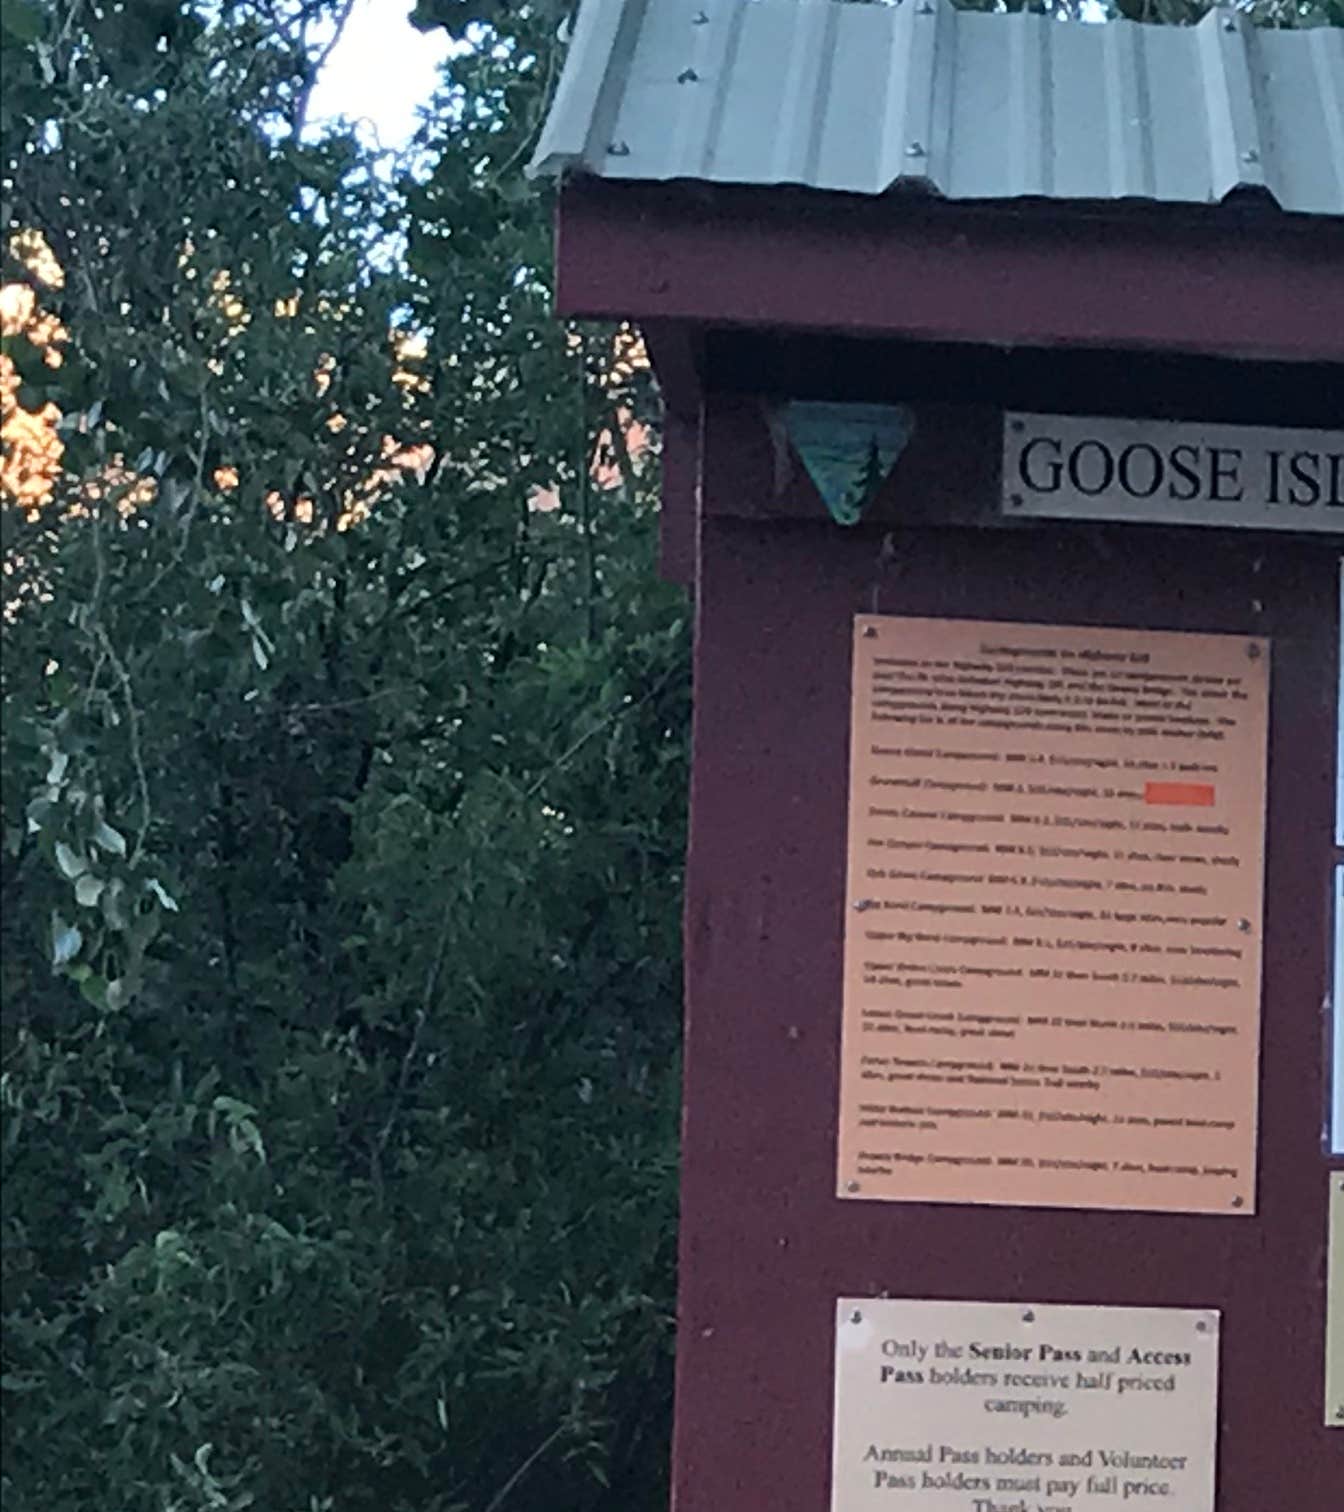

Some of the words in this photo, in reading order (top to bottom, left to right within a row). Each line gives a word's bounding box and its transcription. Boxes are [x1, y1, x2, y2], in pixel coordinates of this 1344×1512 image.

[1017, 437, 1244, 504] GOOSE
[881, 1339, 927, 1362] Only
[934, 1341, 963, 1359] the
[969, 1342, 1033, 1361] Senior
[1038, 1344, 1082, 1363] Pass
[1087, 1346, 1121, 1364] and
[1127, 1348, 1191, 1366] Access
[880, 1365, 925, 1384] Pass
[929, 1367, 998, 1386] holders
[1003, 1373, 1069, 1389] receive
[1075, 1372, 1113, 1390] half
[1117, 1375, 1175, 1395] priced
[984, 1399, 1068, 1419] camping.
[863, 1444, 933, 1463] Annual
[939, 1445, 980, 1465] Pass
[985, 1447, 1054, 1467] holders
[1058, 1449, 1093, 1468] and
[1098, 1450, 1188, 1470] Volunteer
[874, 1470, 916, 1489] Pass
[921, 1471, 991, 1491] holders
[995, 1477, 1041, 1493] must
[1045, 1480, 1079, 1498] pay
[1086, 1475, 1118, 1494] full
